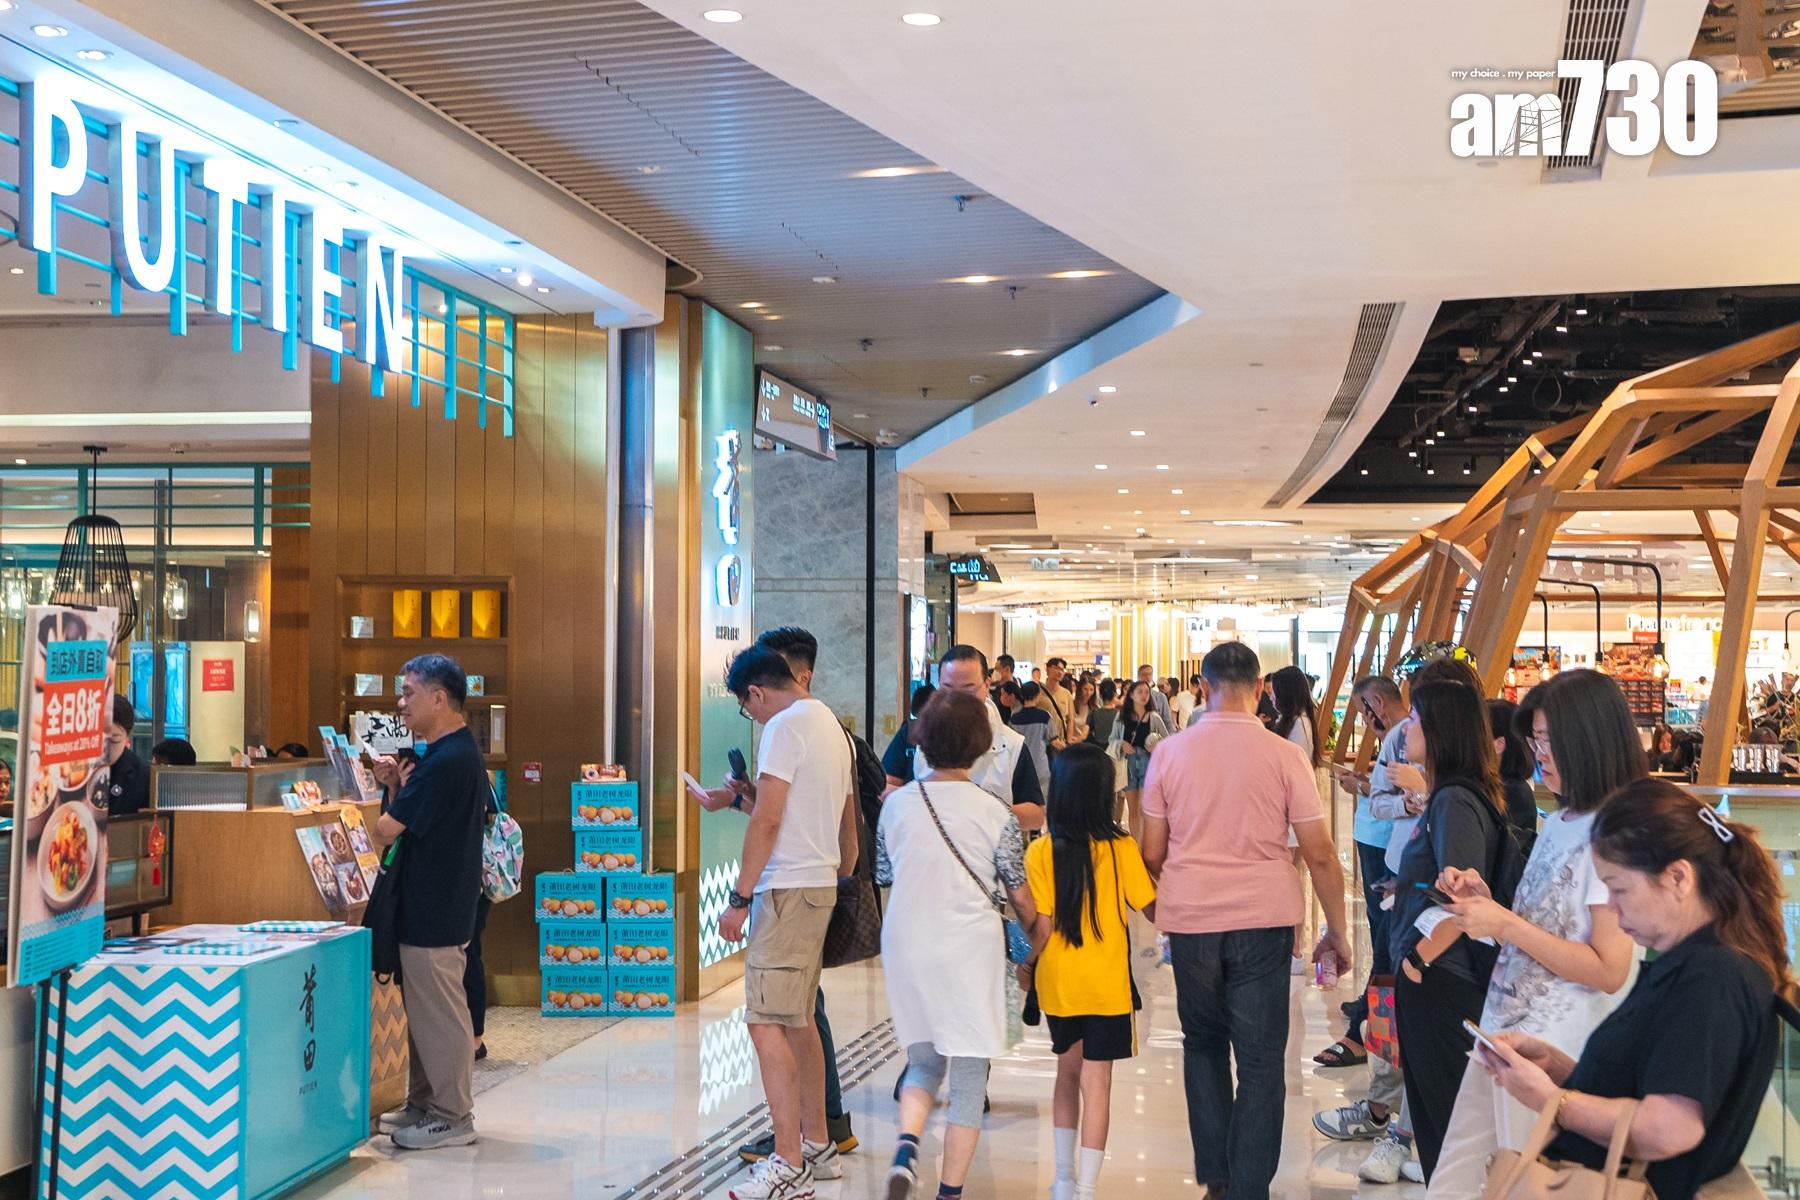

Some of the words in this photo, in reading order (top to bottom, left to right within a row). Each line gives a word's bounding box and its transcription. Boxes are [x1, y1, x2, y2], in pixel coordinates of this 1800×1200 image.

[30, 76, 404, 374] PUTIEN
[45, 688, 102, 736] 全日8折
[428, 1124, 452, 1135] HOKA
